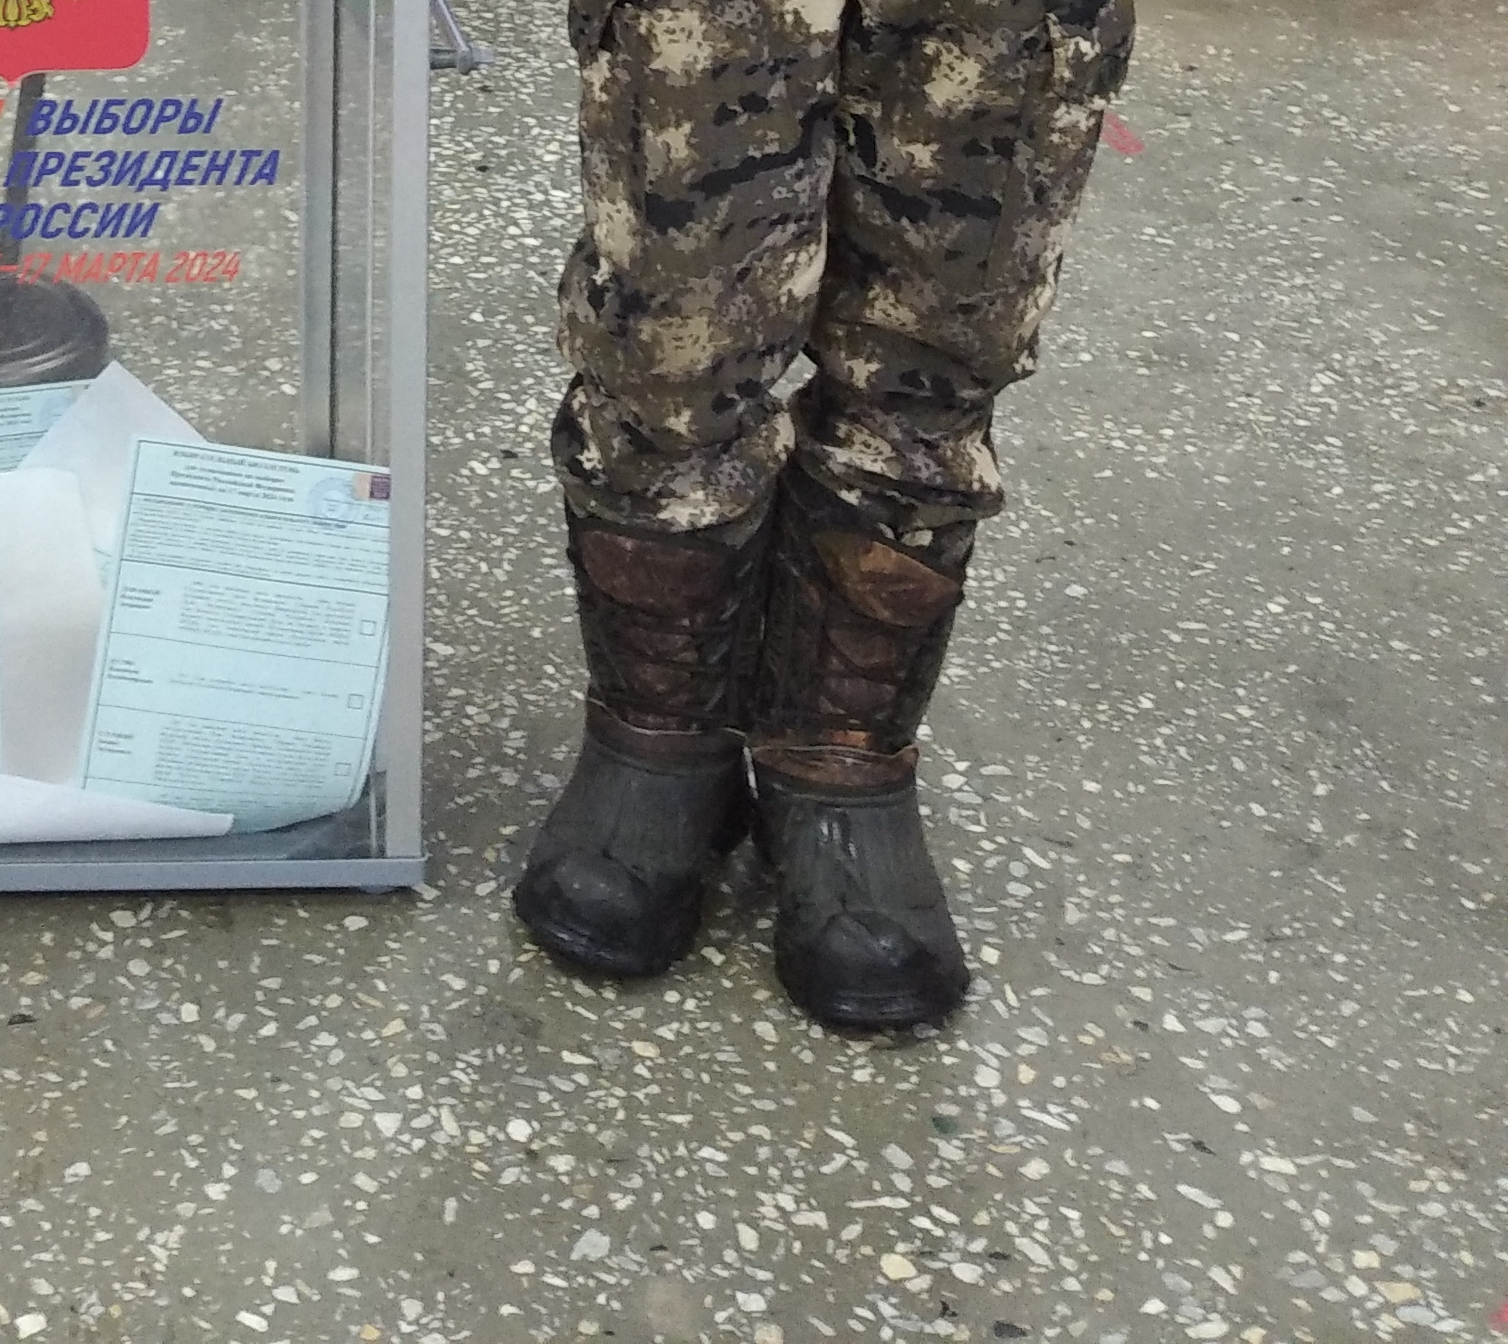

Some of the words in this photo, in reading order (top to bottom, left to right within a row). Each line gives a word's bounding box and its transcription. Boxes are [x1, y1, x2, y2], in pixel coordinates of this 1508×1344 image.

[25, 98, 224, 137] ВЫБОРЫ
[3, 148, 281, 192] ПРЕЗИДЕНТА
[51, 250, 161, 285] МАРТА
[164, 250, 242, 285] 2024
